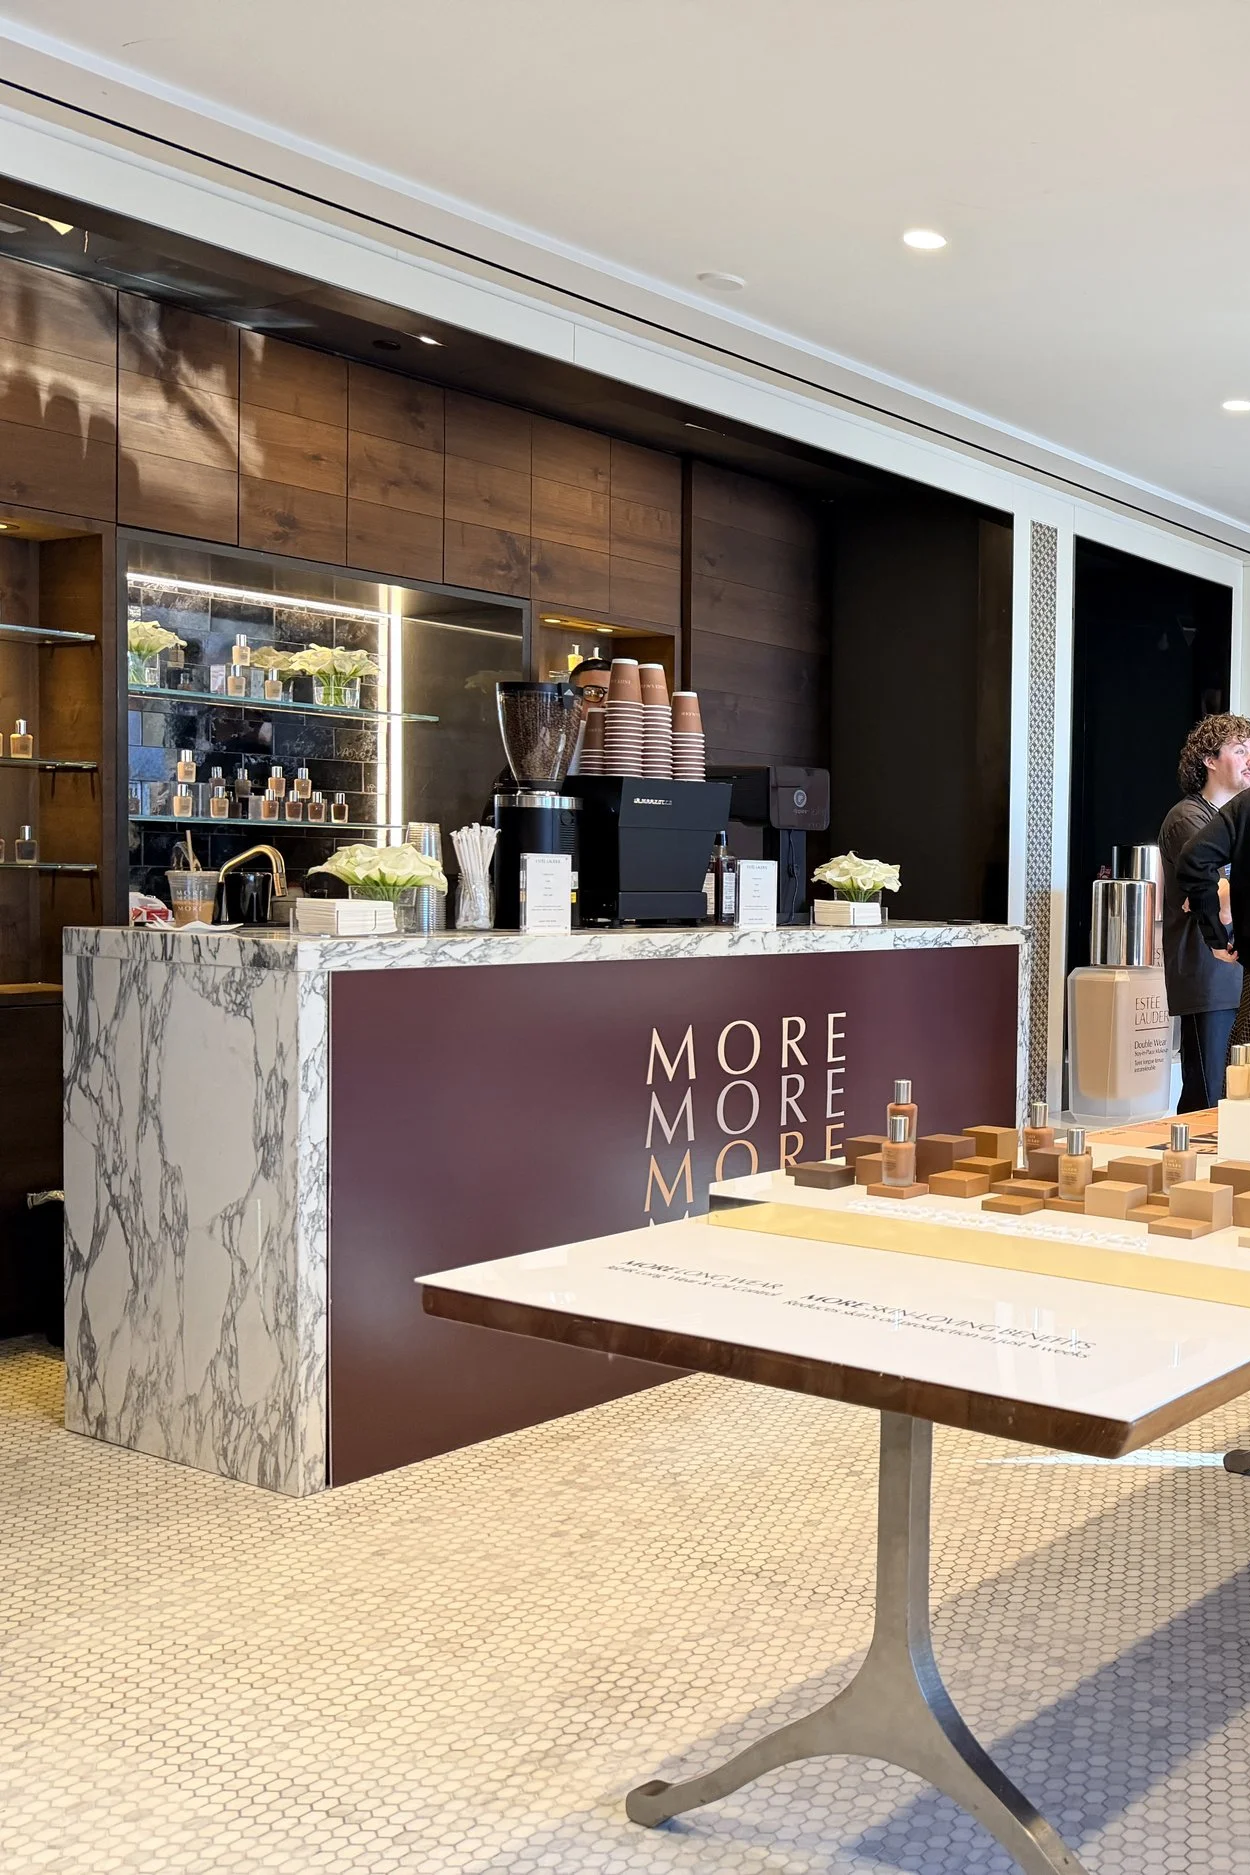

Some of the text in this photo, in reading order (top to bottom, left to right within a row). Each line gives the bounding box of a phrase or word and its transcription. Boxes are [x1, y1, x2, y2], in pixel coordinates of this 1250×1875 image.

[646, 1011, 847, 1085] MORE
[1134, 1010, 1169, 1025] LAUDER
[644, 1067, 846, 1149] MORE
[644, 1122, 845, 1213] MORE
[620, 1259, 783, 1290] MORE LONG WEAR
[800, 1293, 1097, 1350] MORE SKIN-LOVING BENEFITS
